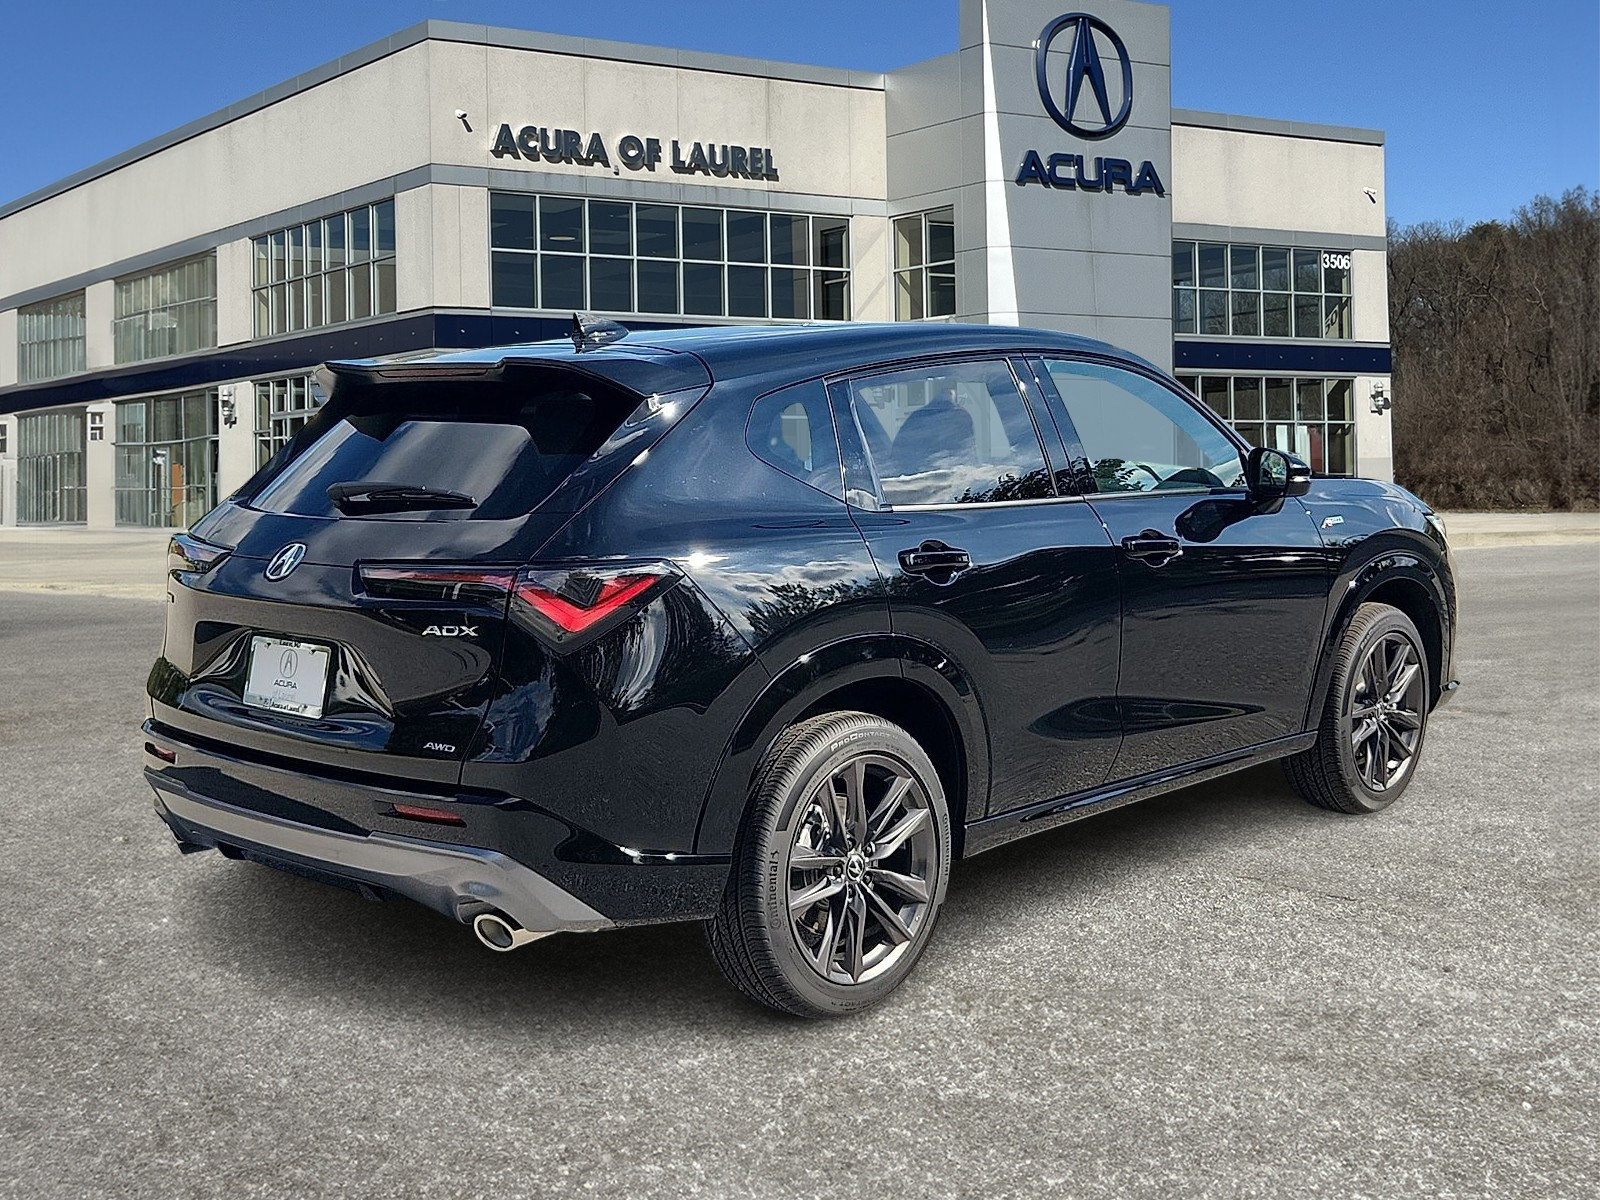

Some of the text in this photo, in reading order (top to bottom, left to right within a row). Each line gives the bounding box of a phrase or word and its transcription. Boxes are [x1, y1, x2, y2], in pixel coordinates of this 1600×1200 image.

[491, 124, 778, 180] ACURA OF LAUREL
[1016, 150, 1165, 196] ACURA
[1323, 253, 1350, 270] 3506
[422, 625, 479, 637] ADX
[274, 679, 298, 690] ACURA
[423, 742, 456, 753] AWD
